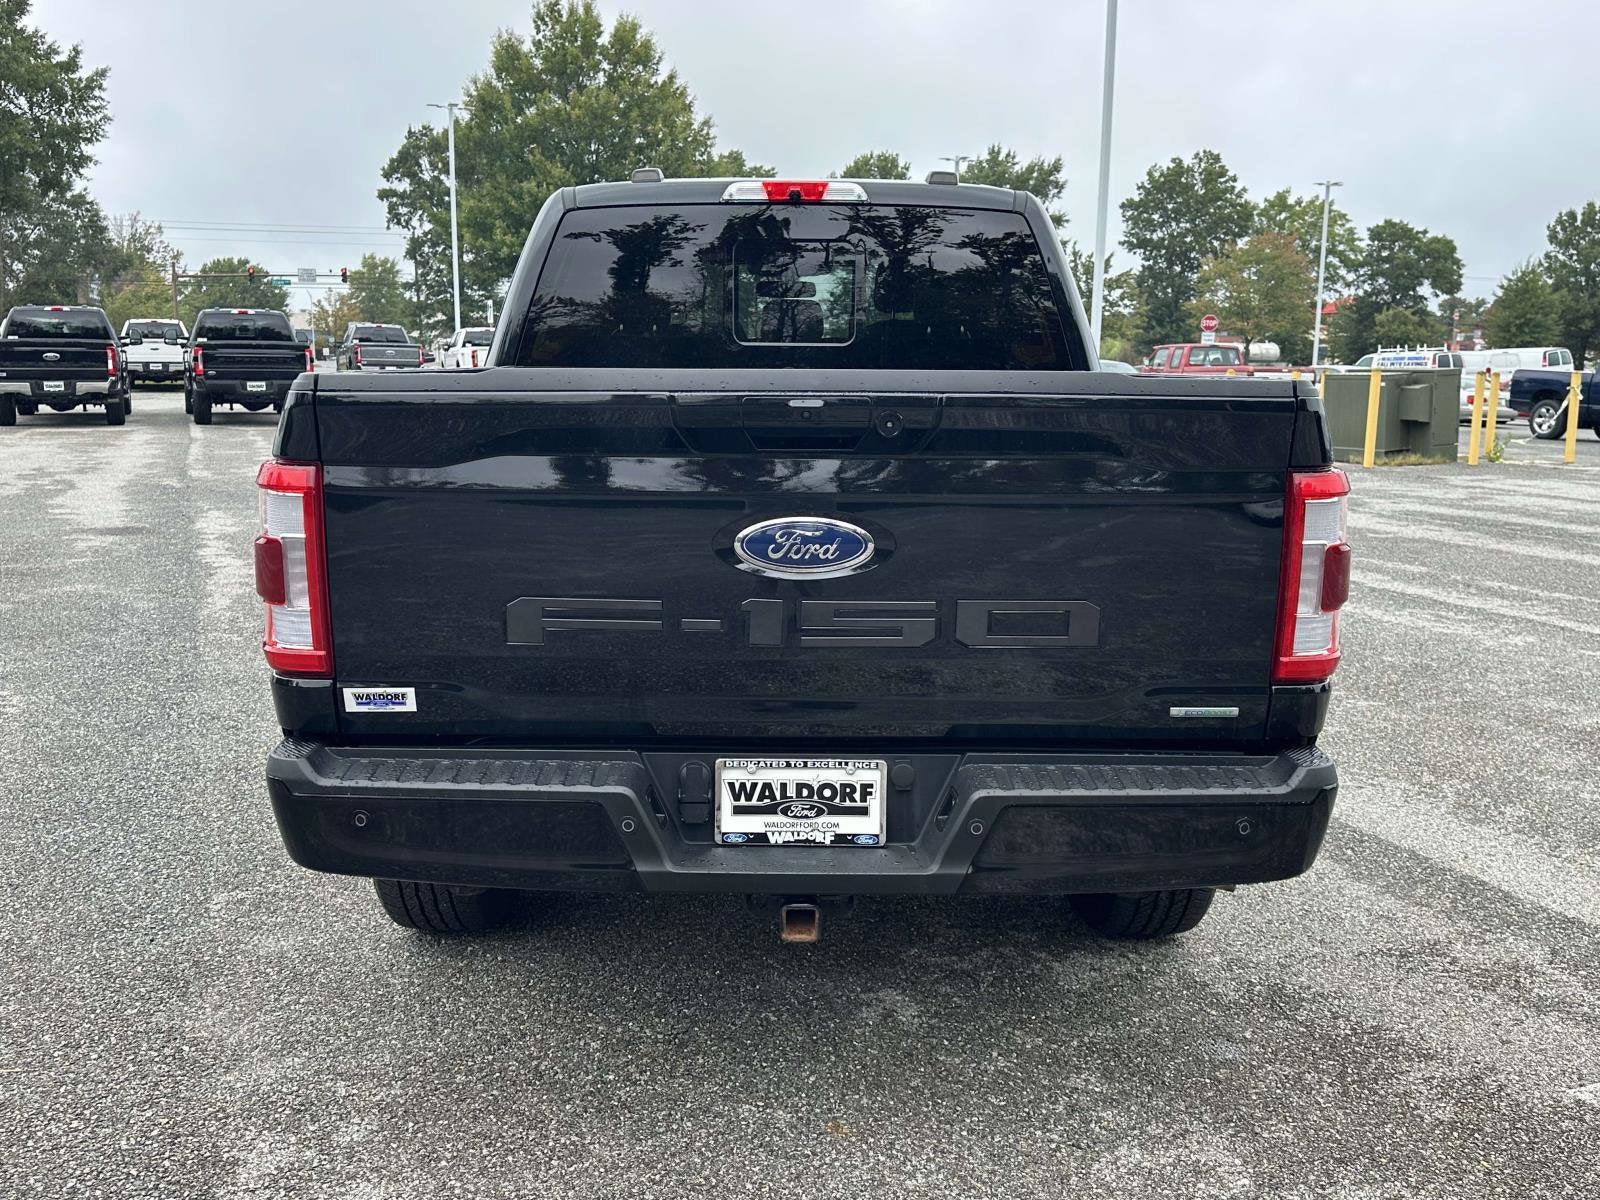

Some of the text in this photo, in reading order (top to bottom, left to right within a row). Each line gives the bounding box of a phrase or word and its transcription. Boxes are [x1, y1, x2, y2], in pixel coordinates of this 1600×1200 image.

[767, 529, 841, 560] Ford
[506, 597, 1102, 648] F-150
[353, 693, 407, 701] WALDORF
[725, 760, 787, 768] DEDICATED
[727, 781, 875, 803] WALDORF
[787, 804, 817, 818] Ford
[764, 821, 840, 829] WALDORFFORD.COM
[766, 830, 836, 845] WALDORF
